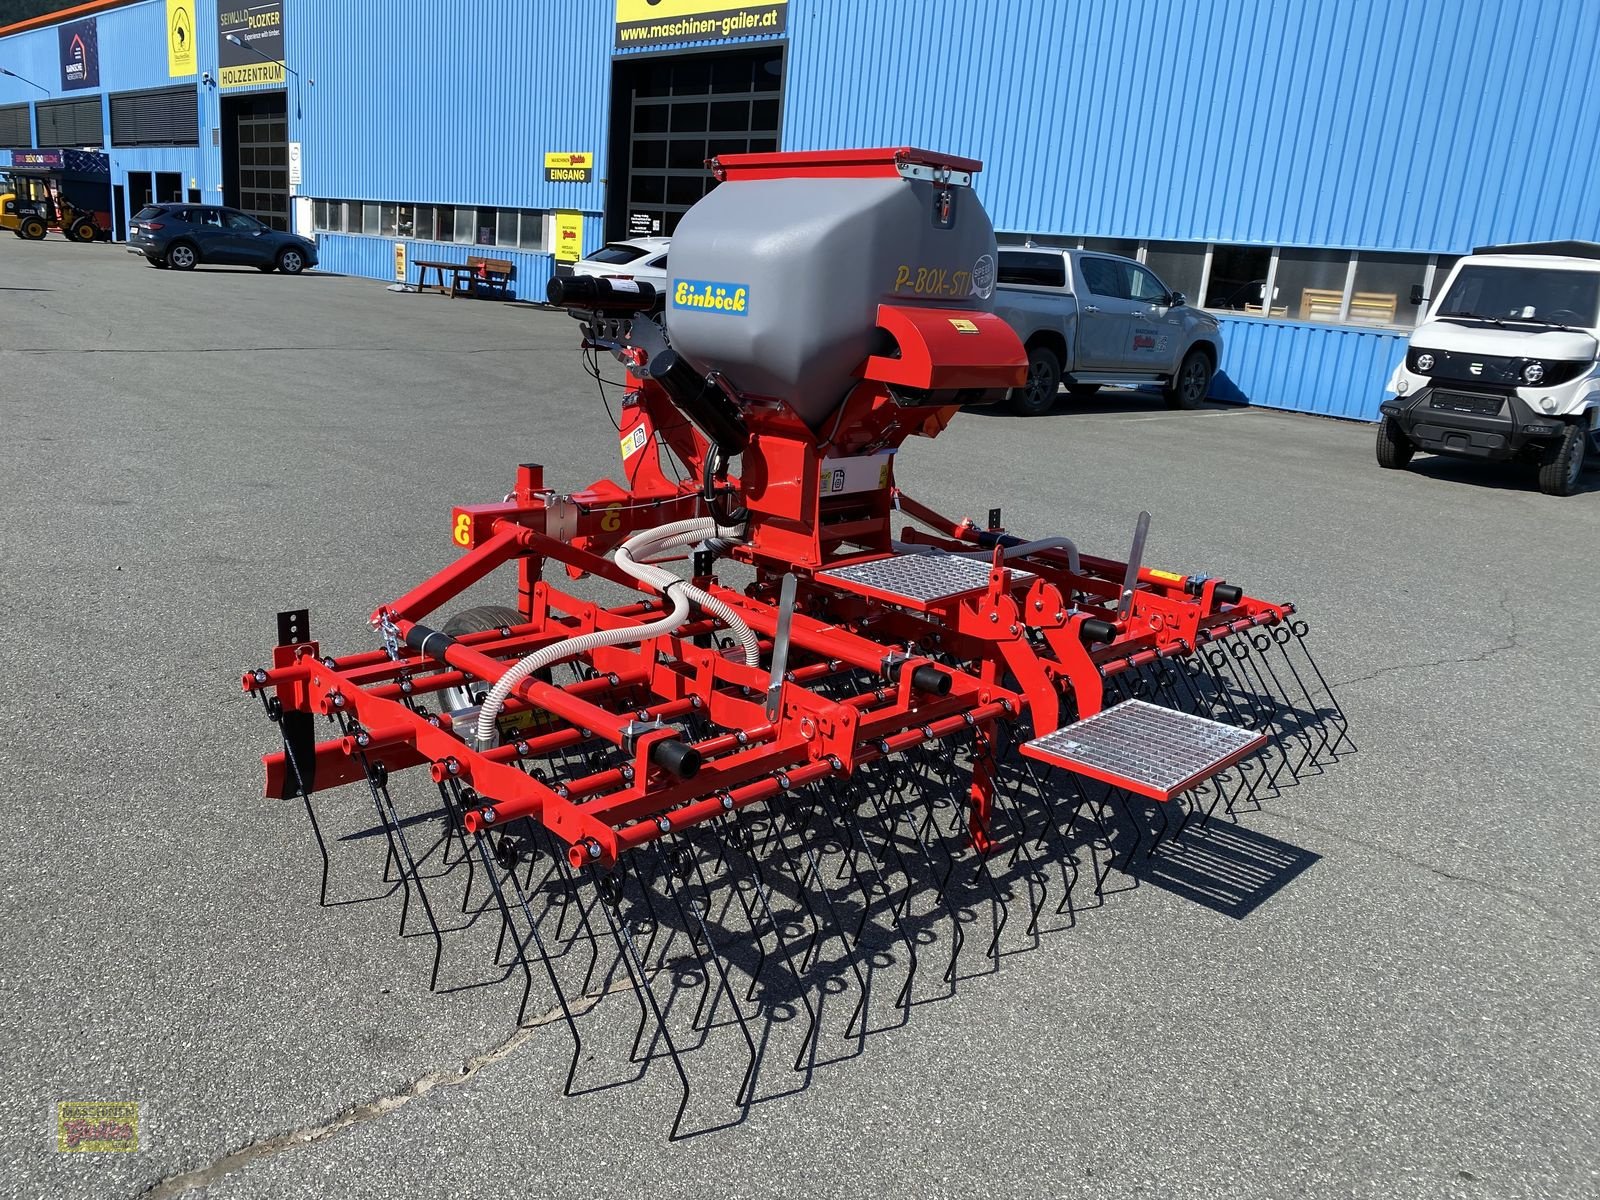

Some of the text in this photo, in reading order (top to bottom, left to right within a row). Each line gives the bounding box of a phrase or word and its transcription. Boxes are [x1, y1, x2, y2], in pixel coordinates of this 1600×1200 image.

[248, 11, 280, 29] PLOZKER
[620, 9, 778, 40] www.maschinen-gailer.at
[222, 65, 282, 84] HOLZZENTRUM
[550, 168, 585, 181] EINGANG
[675, 281, 746, 312] Einböck
